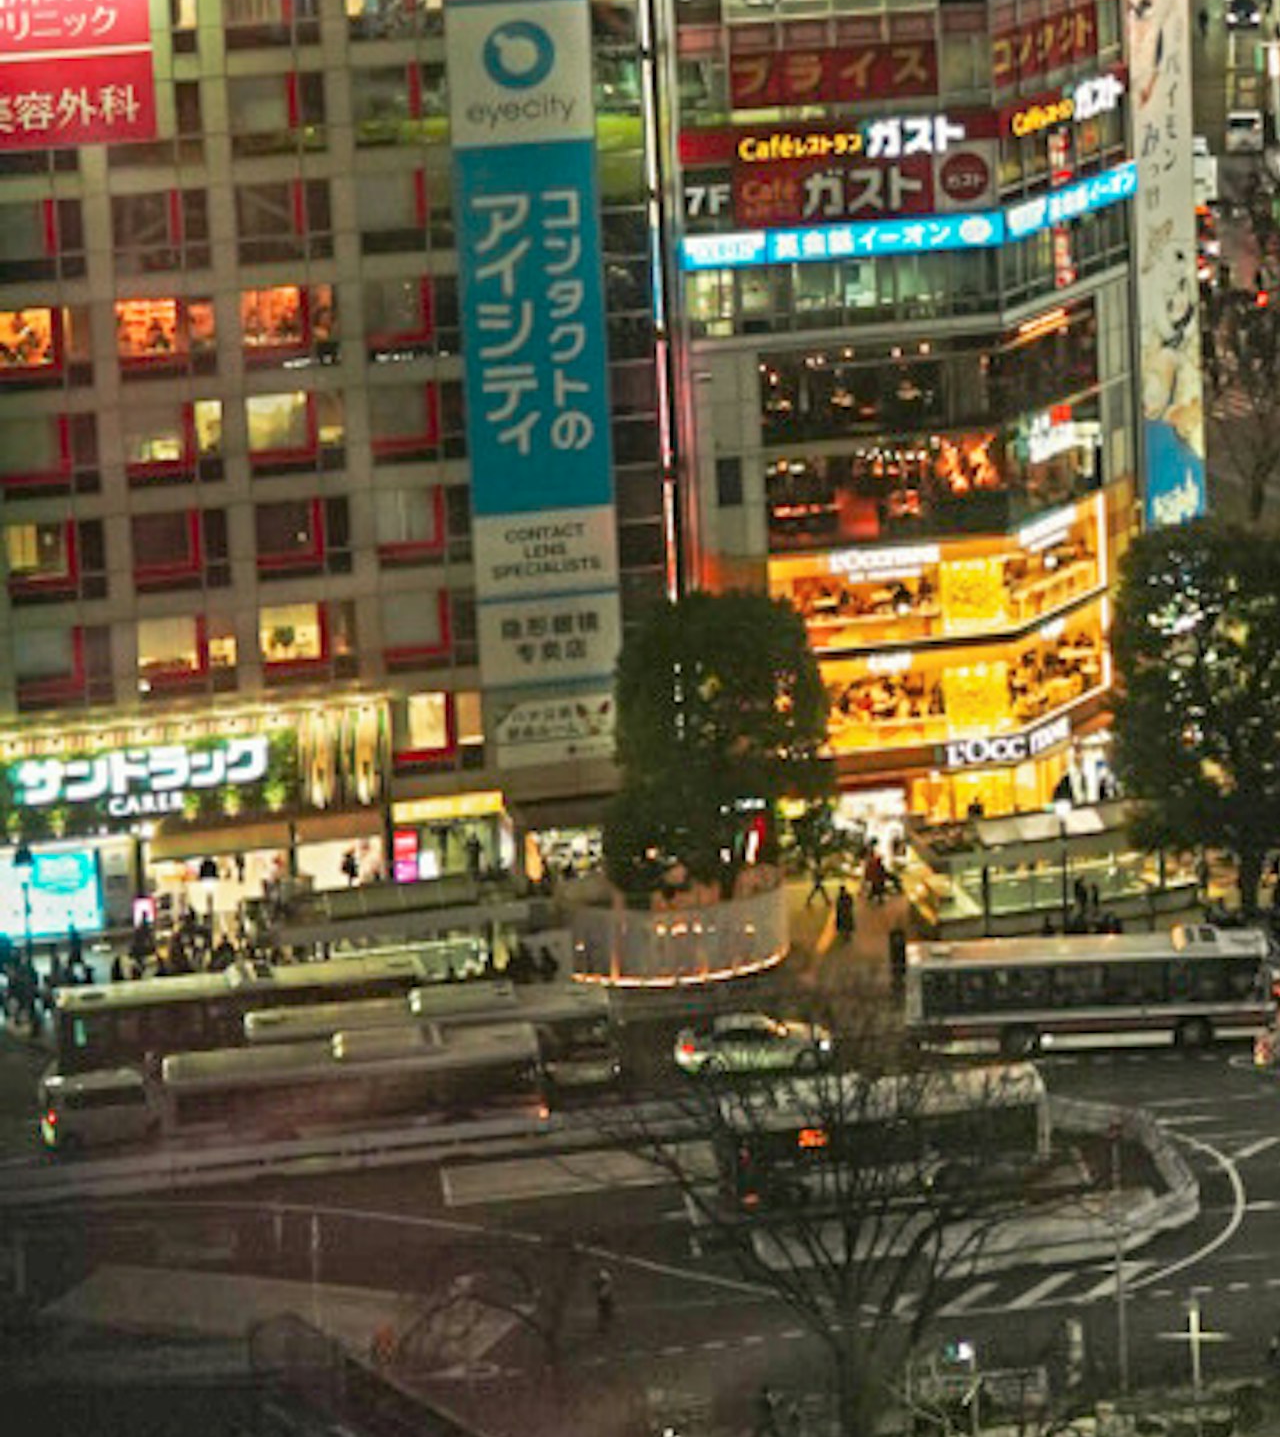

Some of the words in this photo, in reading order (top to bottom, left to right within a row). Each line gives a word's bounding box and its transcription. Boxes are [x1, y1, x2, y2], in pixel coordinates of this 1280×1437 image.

[466, 94, 575, 129] eyecity
[867, 115, 964, 158] ガスト
[684, 184, 729, 216] 7F
[804, 166, 922, 218] ガスト
[470, 192, 538, 457] アイシティ
[541, 188, 592, 451] コンタクトの
[505, 524, 584, 543] CONTACT
[523, 542, 567, 559] LENS
[492, 557, 601, 579] SPECIALISTS
[17, 737, 268, 807] サンドラッグ
